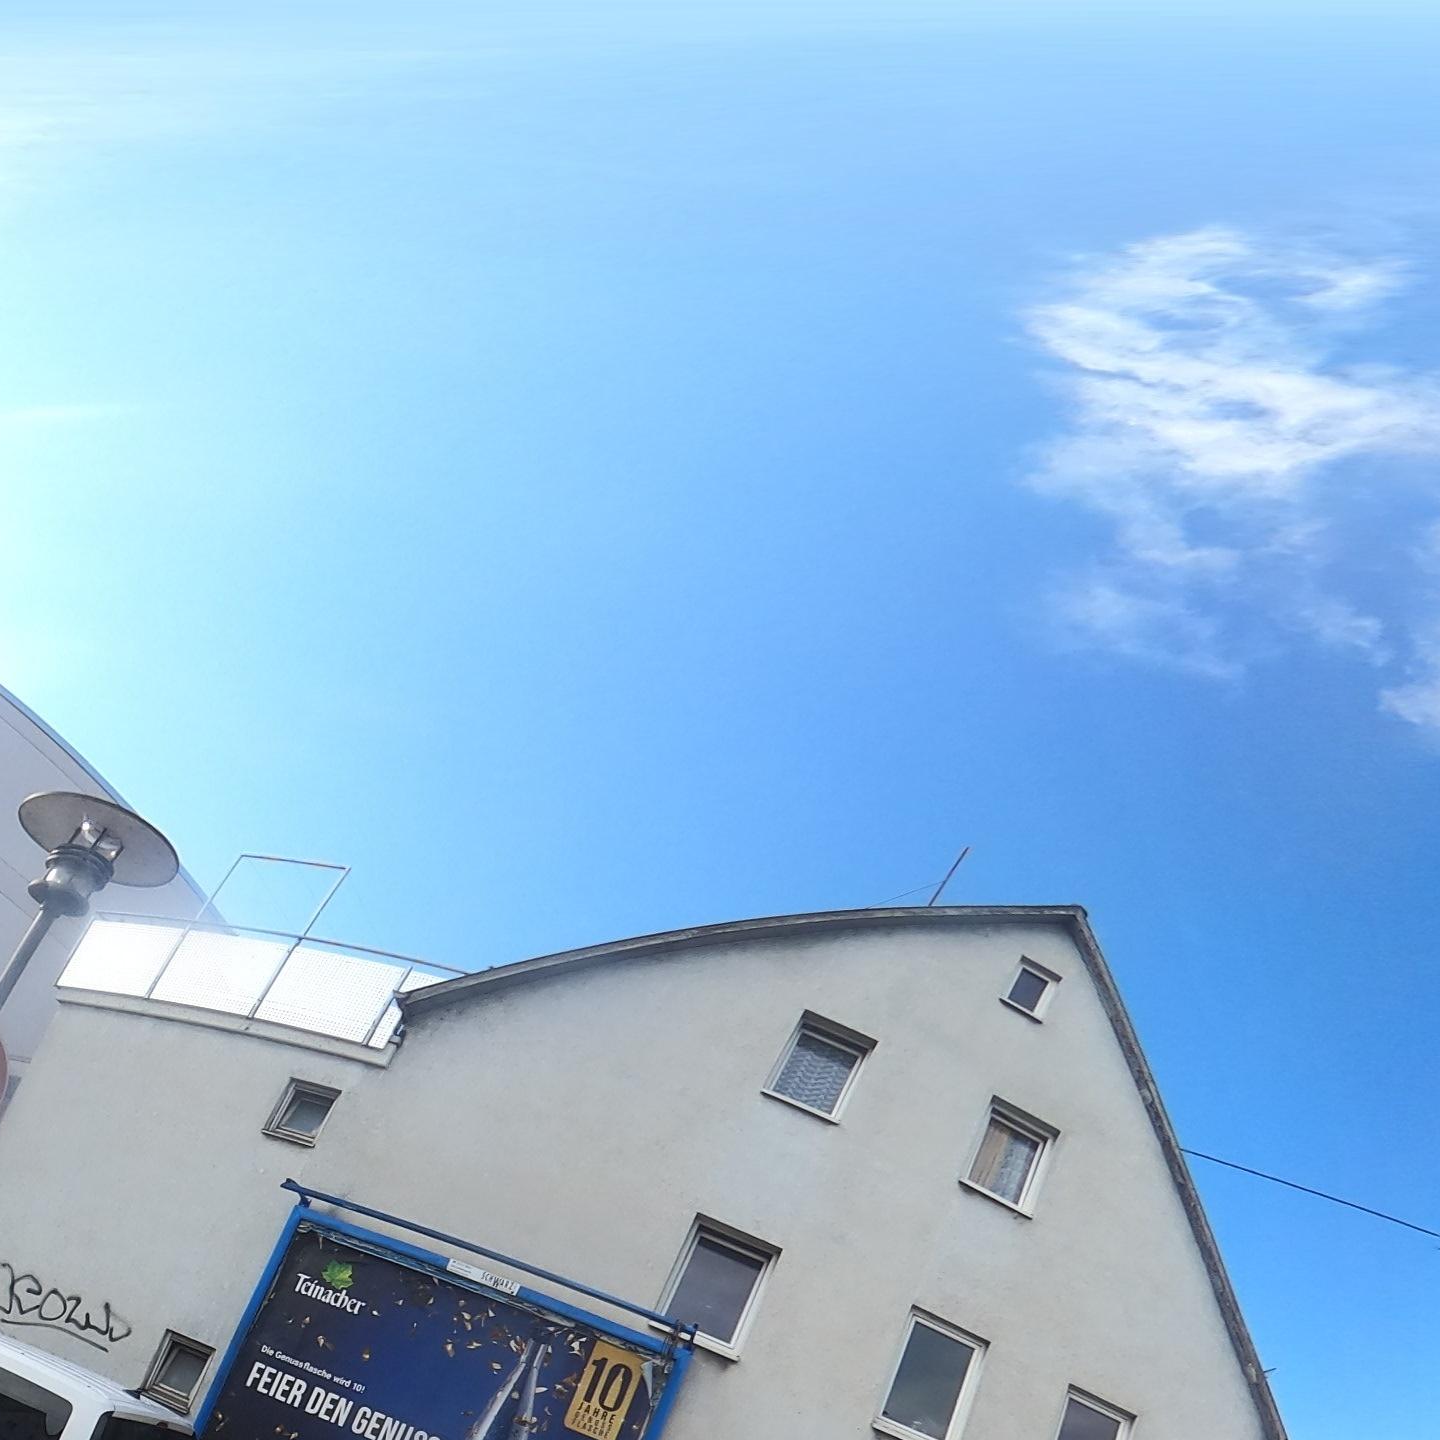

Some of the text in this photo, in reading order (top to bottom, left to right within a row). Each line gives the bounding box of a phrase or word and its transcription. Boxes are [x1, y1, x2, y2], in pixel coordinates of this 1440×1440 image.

[294, 1273, 366, 1315] Teinacher
[261, 1345, 275, 1357] Die
[333, 1374, 352, 1388] wird
[353, 1381, 366, 1394] 10!
[583, 1357, 633, 1412] 10
[245, 1361, 307, 1408] FEIER
[304, 1386, 354, 1428] DEN
[578, 1402, 616, 1425] JAHRE
